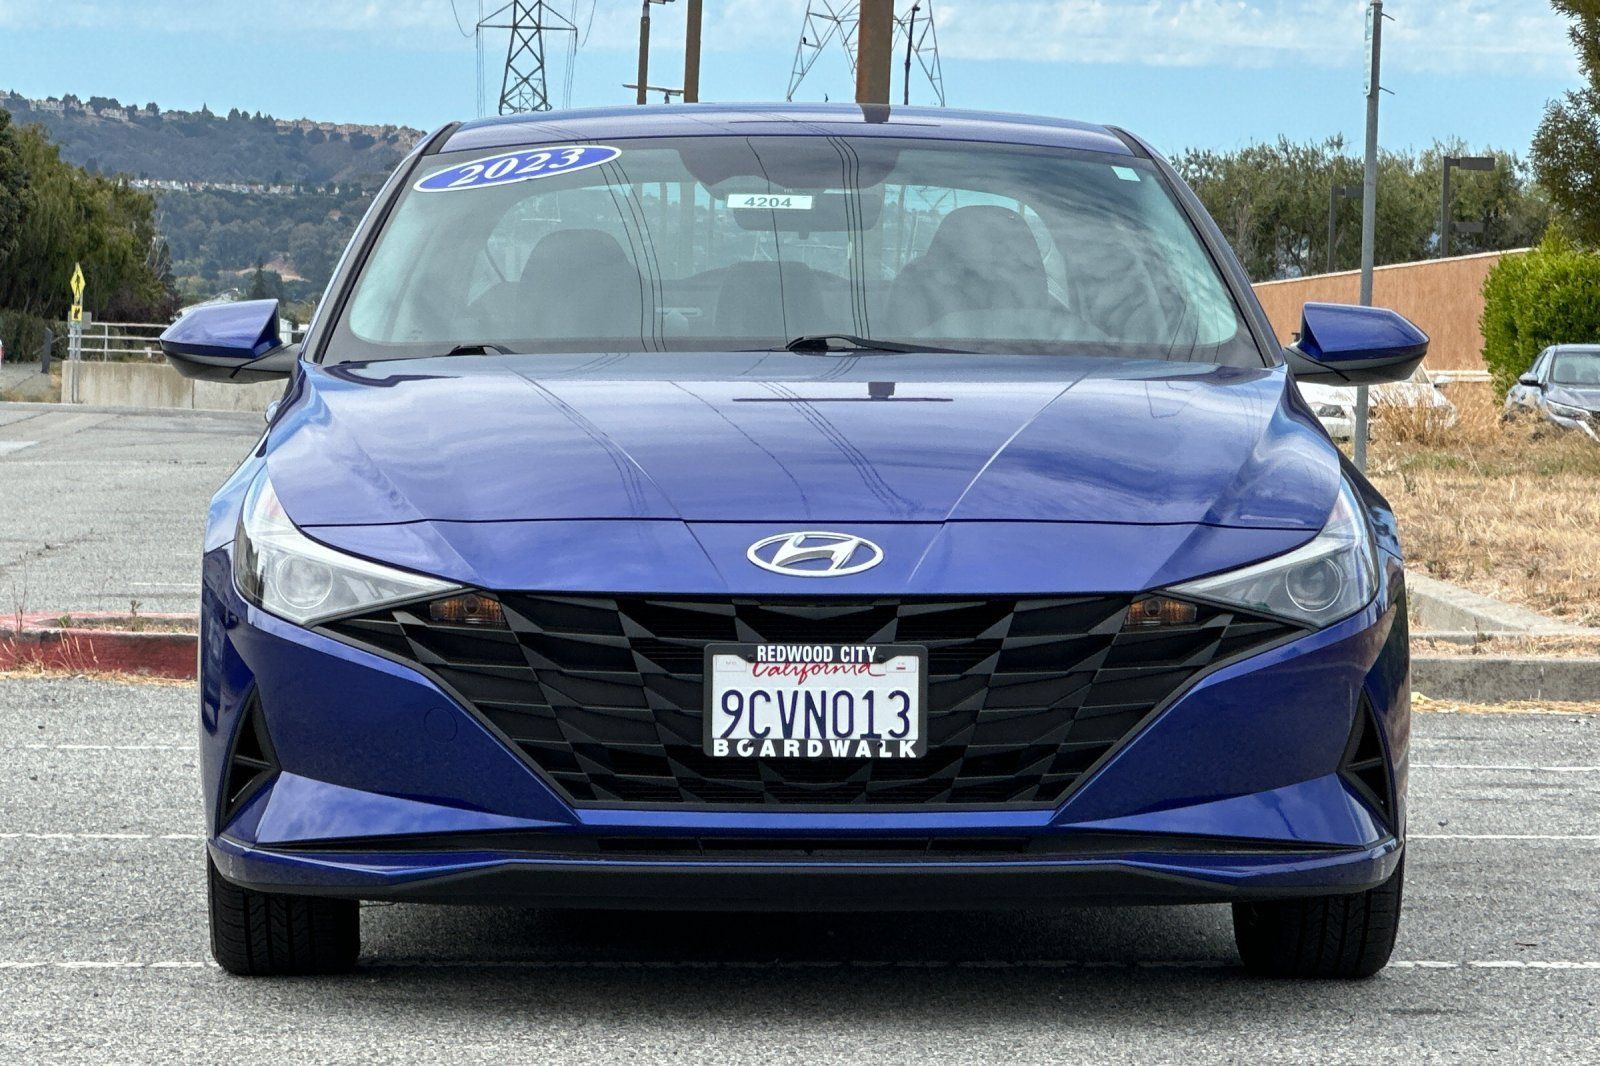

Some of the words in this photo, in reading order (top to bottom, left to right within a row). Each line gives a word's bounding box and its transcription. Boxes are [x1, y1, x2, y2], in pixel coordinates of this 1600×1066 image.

[448, 148, 585, 187] 2023
[744, 197, 792, 207] 4204
[757, 645, 833, 662] REDWOOD
[841, 645, 877, 662] CITY
[752, 661, 886, 685] California
[720, 689, 911, 739] 9CVN013
[713, 739, 917, 758] BOARDWALK
